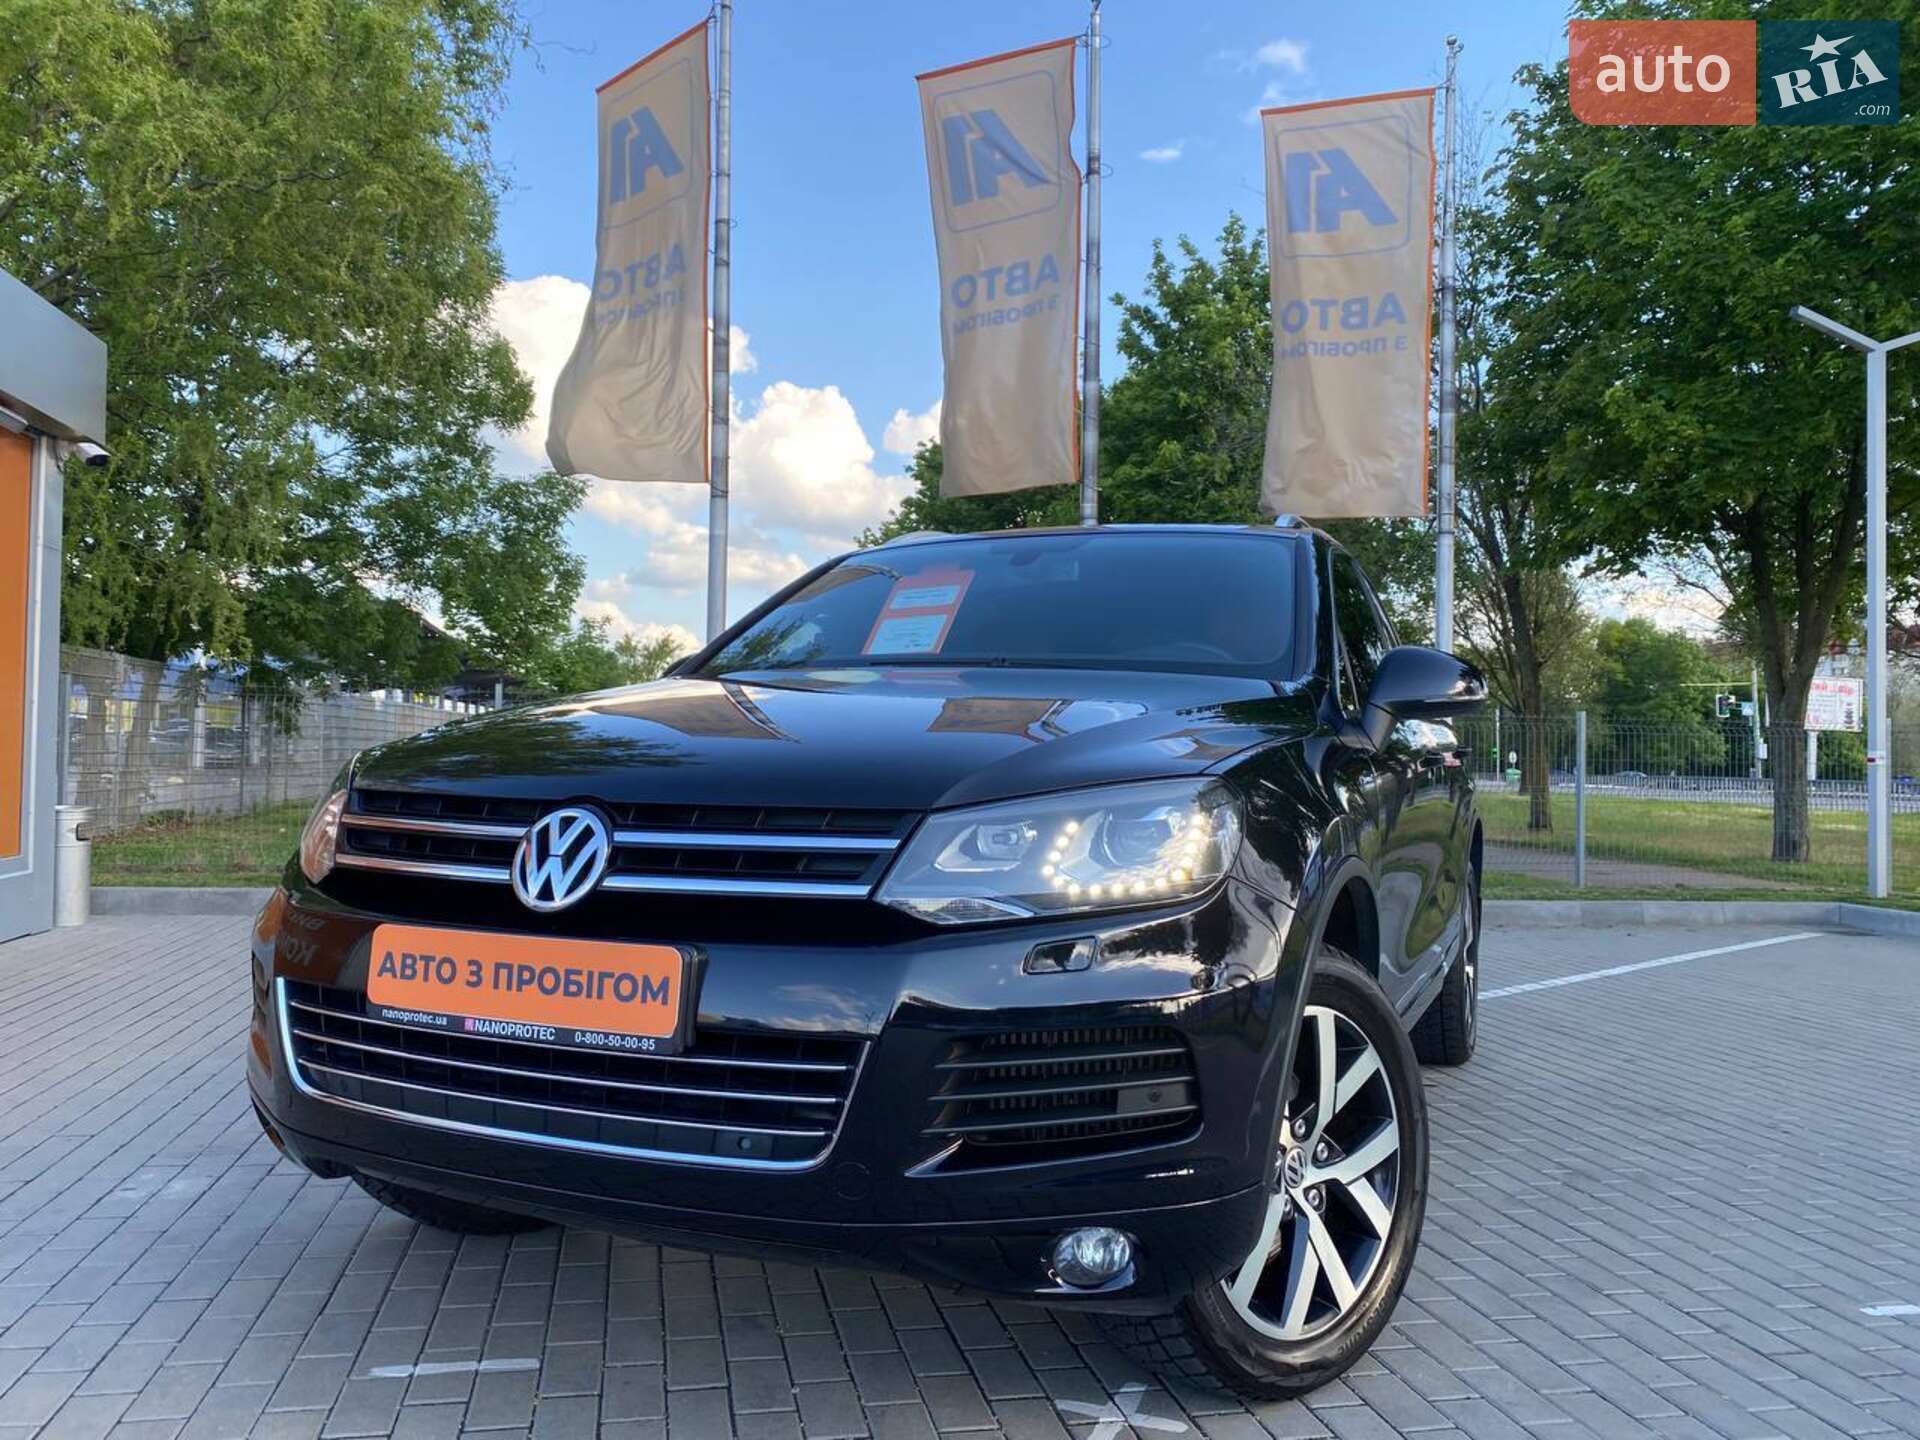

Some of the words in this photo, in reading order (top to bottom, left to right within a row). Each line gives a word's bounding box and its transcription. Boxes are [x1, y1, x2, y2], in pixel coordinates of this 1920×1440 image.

[377, 951, 457, 986] АВТО
[465, 960, 483, 988] З
[493, 962, 671, 1006] ПРОБІГОМ
[382, 1009, 448, 1026] nanoprotec.ua
[474, 1019, 556, 1041] NANOPROTEC
[574, 1031, 656, 1051] 0-800-50-00-95
